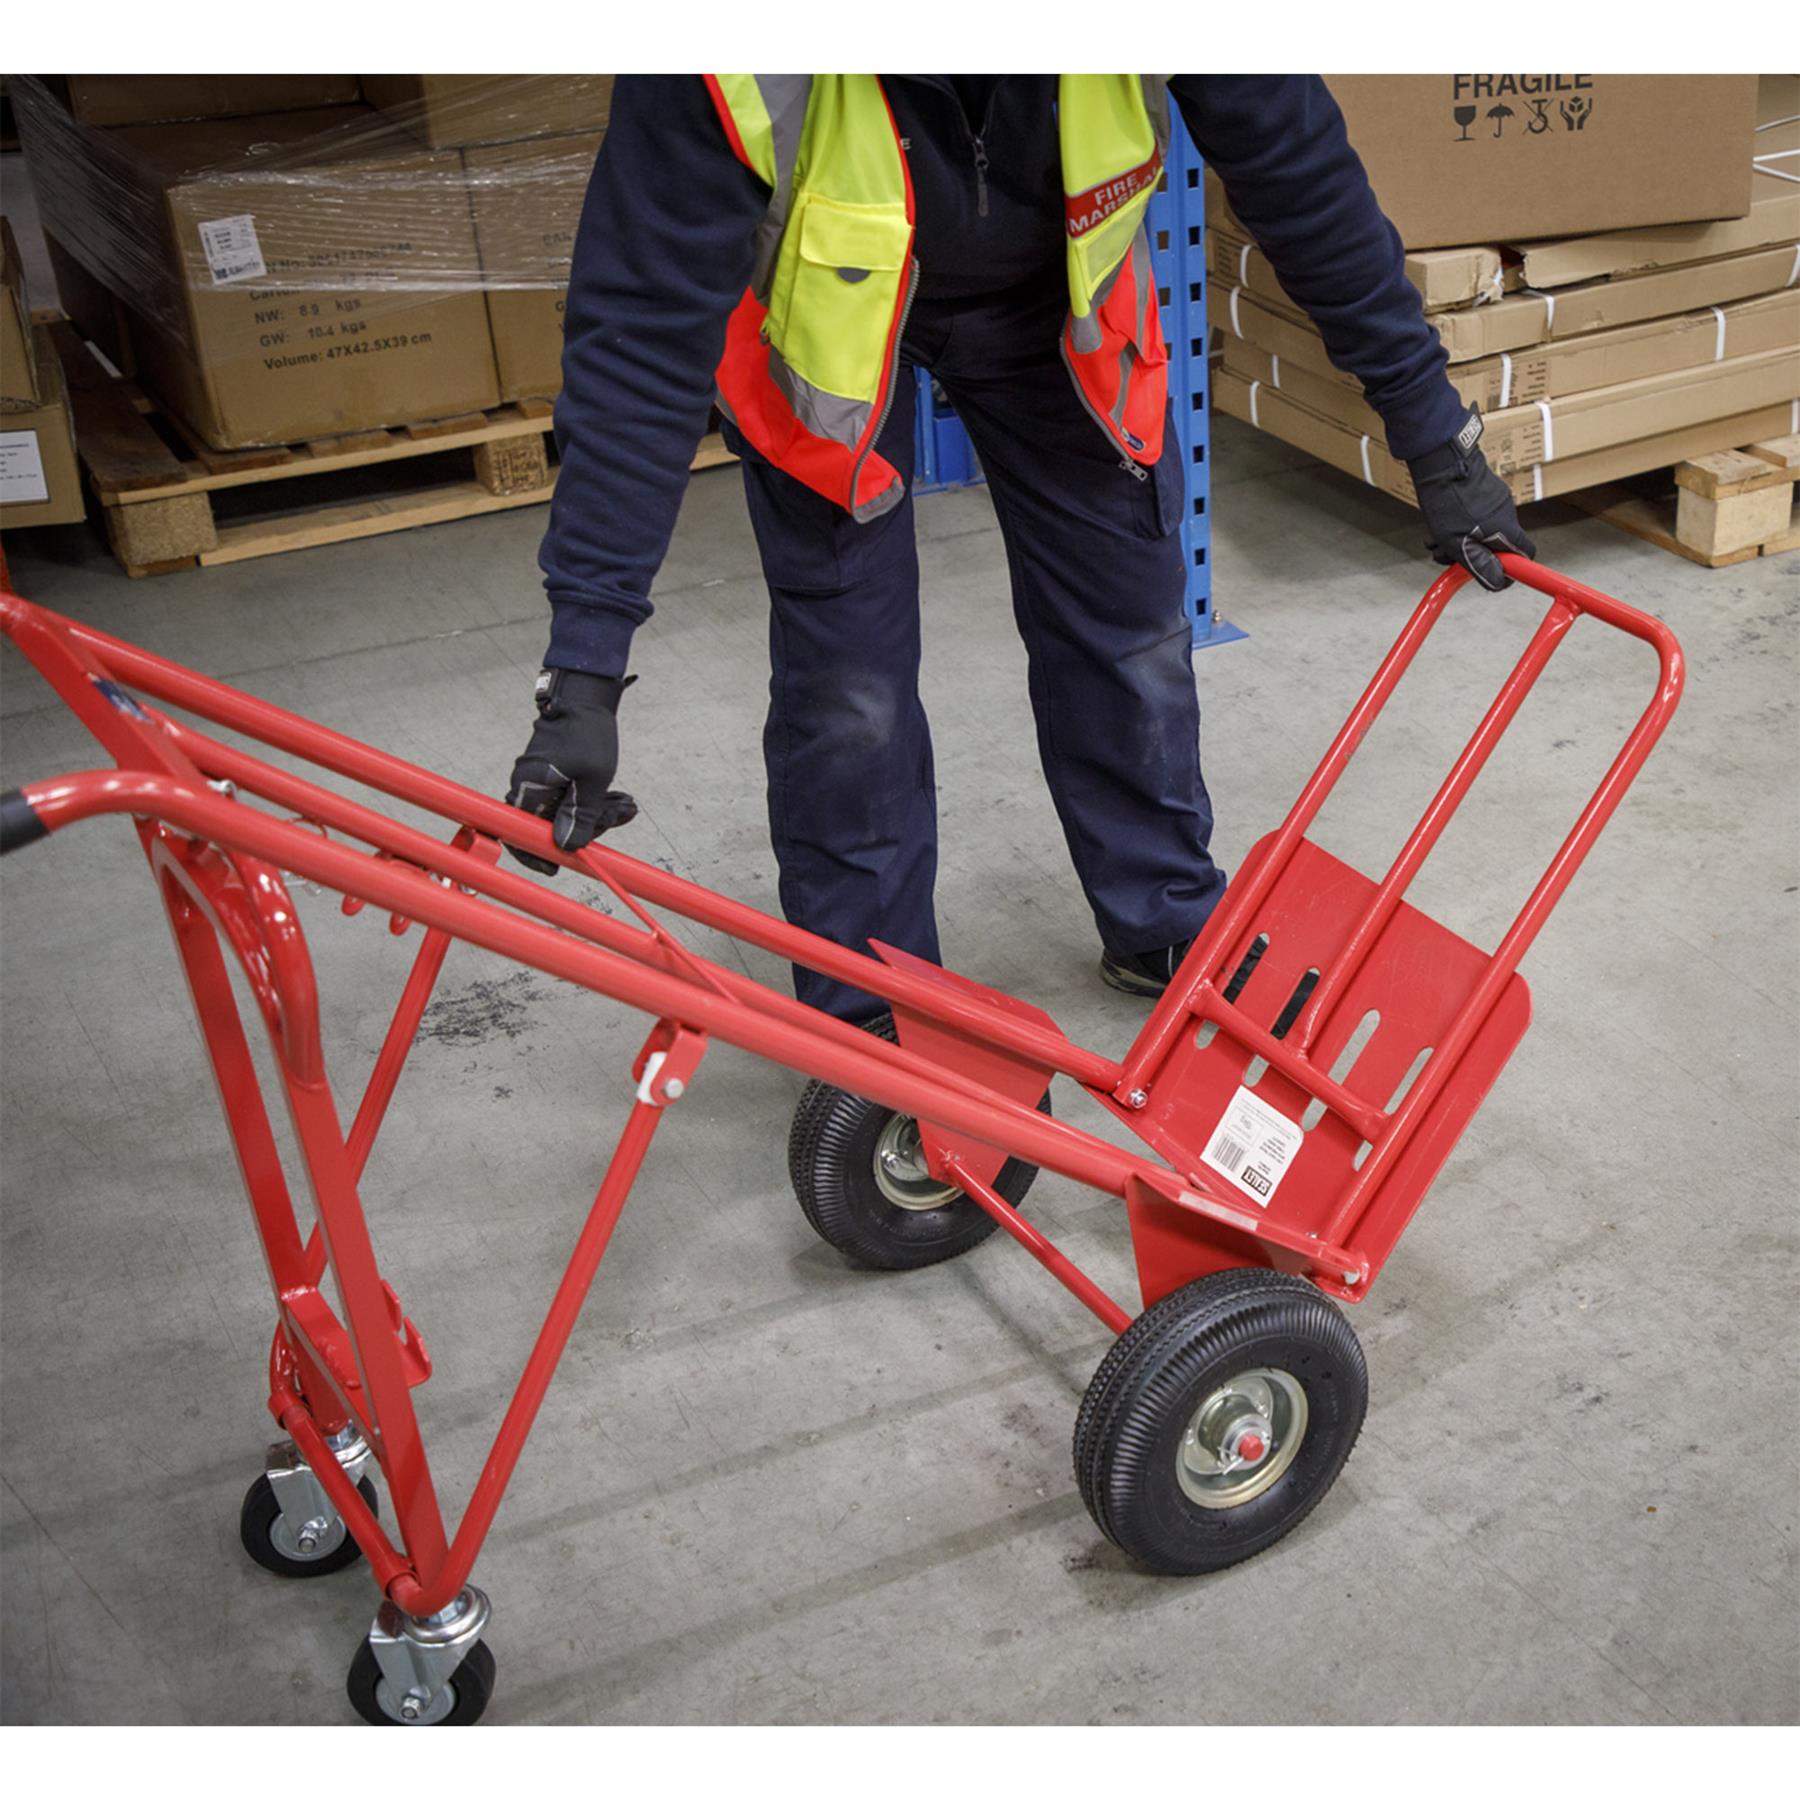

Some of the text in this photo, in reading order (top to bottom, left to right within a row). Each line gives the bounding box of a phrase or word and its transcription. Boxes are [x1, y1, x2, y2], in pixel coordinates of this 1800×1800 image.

[1453, 74, 1593, 100] FRAGILE
[1094, 173, 1138, 206] FIRE
[254, 309, 285, 325] NW:
[335, 299, 361, 313] kgs
[260, 321, 367, 347] GW: 10.4 kgs
[264, 333, 432, 370] Volume: 47X42.5X39 cm
